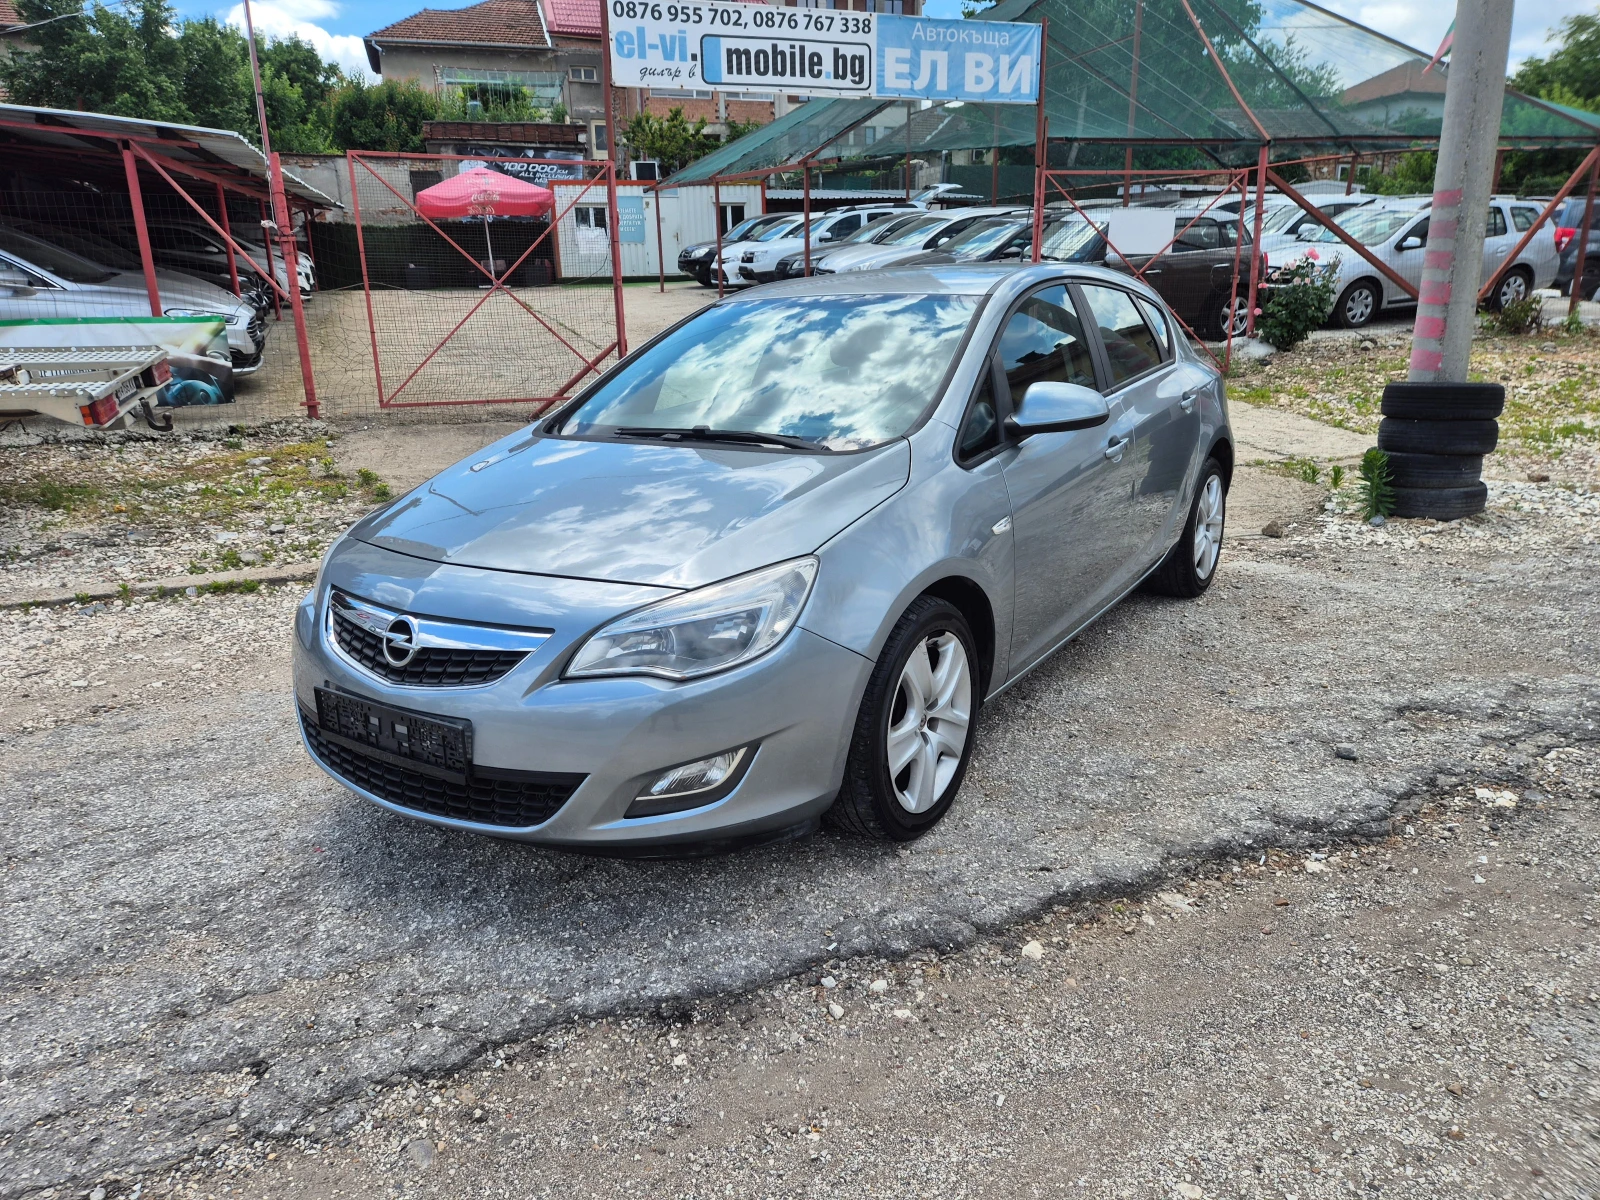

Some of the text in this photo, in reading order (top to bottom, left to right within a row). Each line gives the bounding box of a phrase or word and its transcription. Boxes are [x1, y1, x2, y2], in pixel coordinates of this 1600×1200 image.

[613, 0, 871, 34] 0876 955 702, 0876 767 338
[912, 22, 1009, 47] Автокъща
[726, 43, 865, 85] mobile.bg
[884, 47, 1032, 94] ЕЛ ВИ
[503, 162, 527, 171] 100
[528, 163, 557, 173] 000
